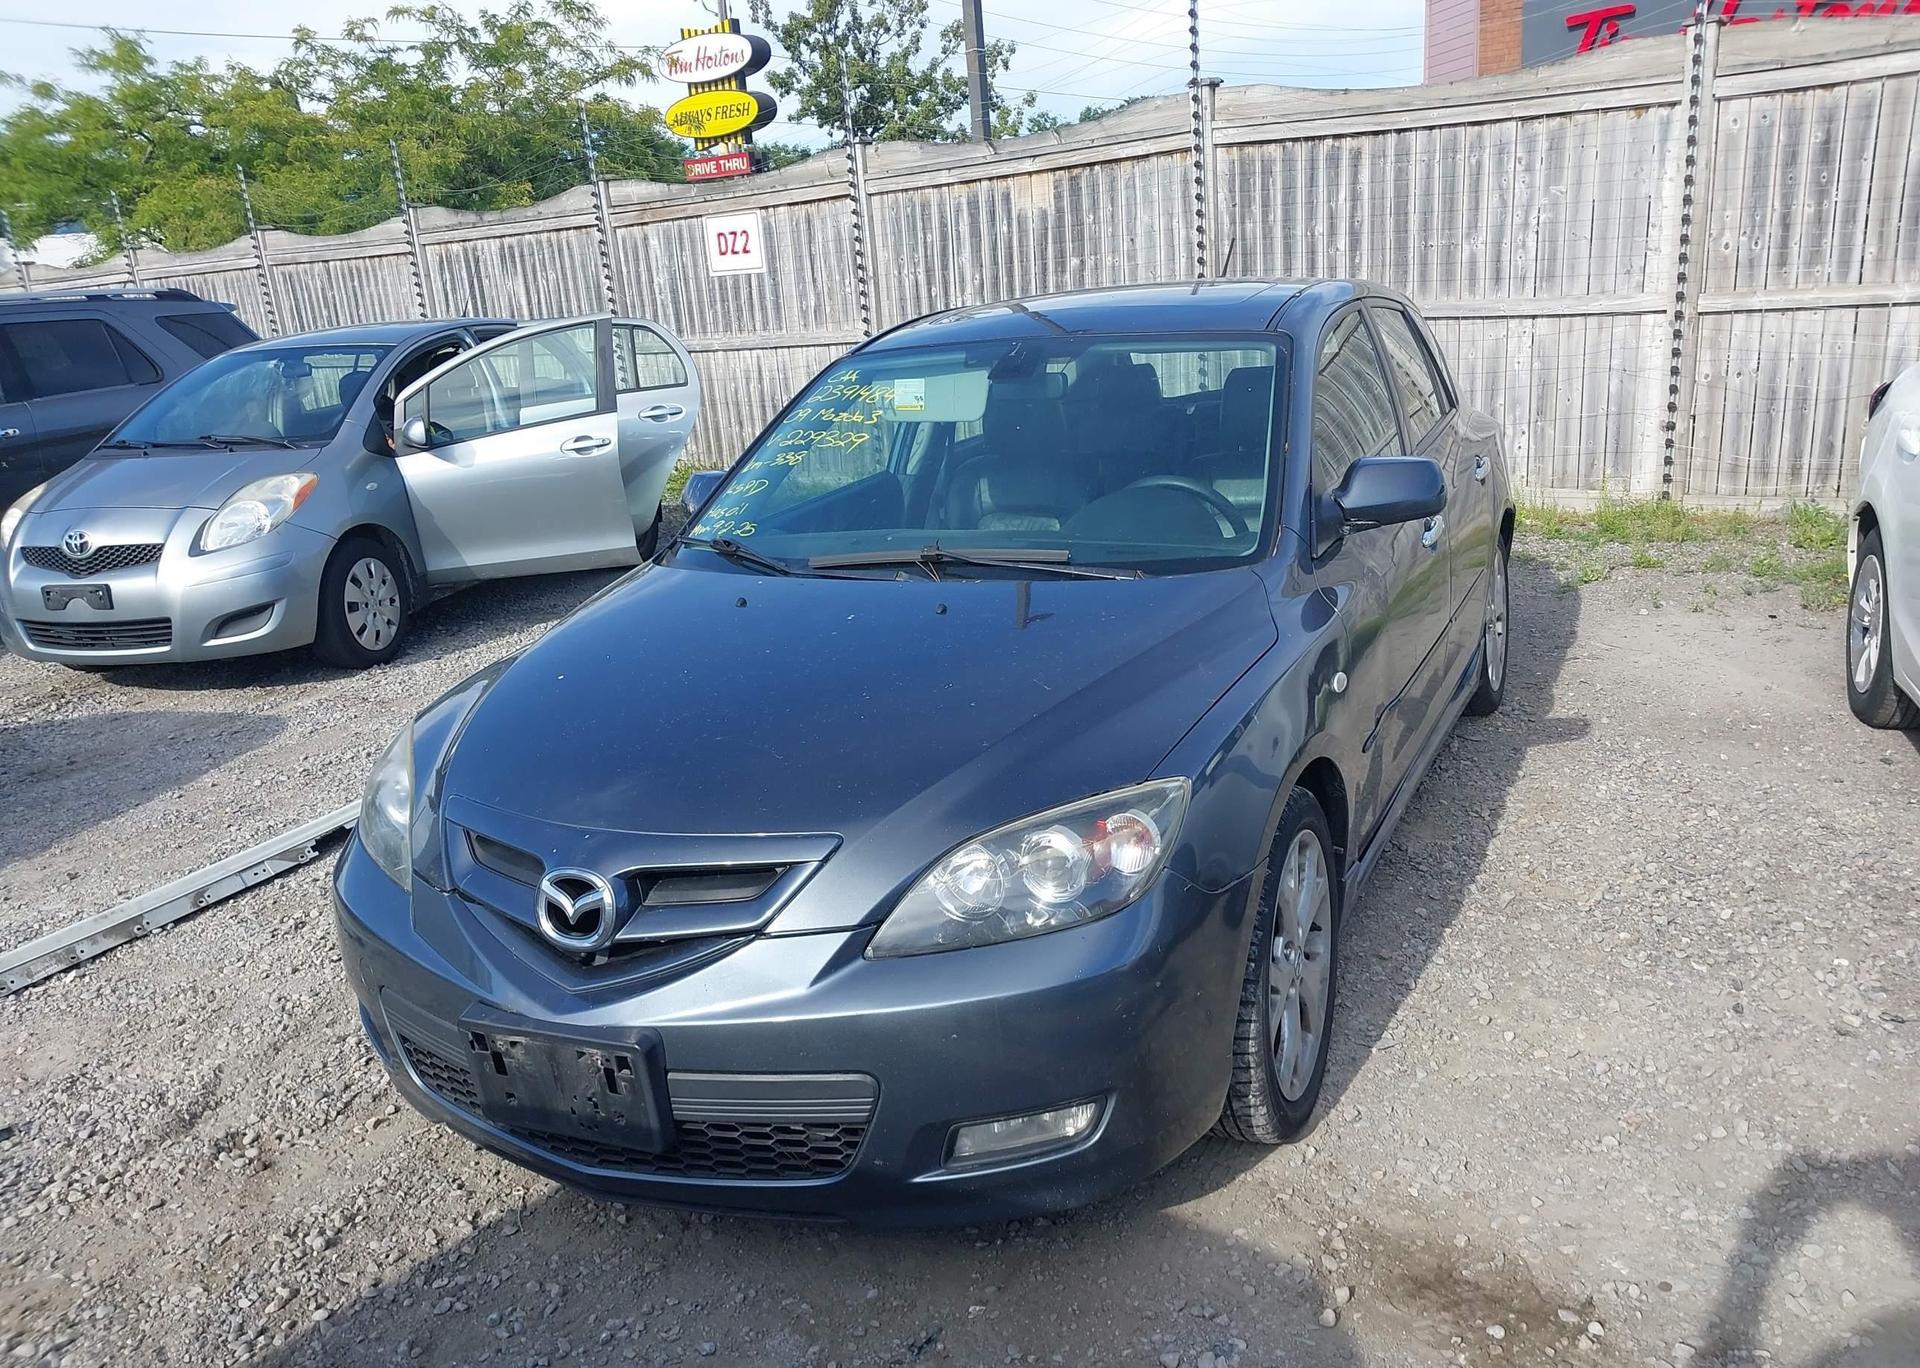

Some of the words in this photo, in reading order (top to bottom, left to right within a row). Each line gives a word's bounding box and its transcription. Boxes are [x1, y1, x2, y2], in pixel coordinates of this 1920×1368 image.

[665, 49, 693, 77] Tim
[695, 44, 745, 73] Hortons
[714, 101, 751, 120] FRESH
[687, 160, 718, 177] DRIVE
[719, 156, 748, 174] THRU
[716, 229, 752, 257] DZ2
